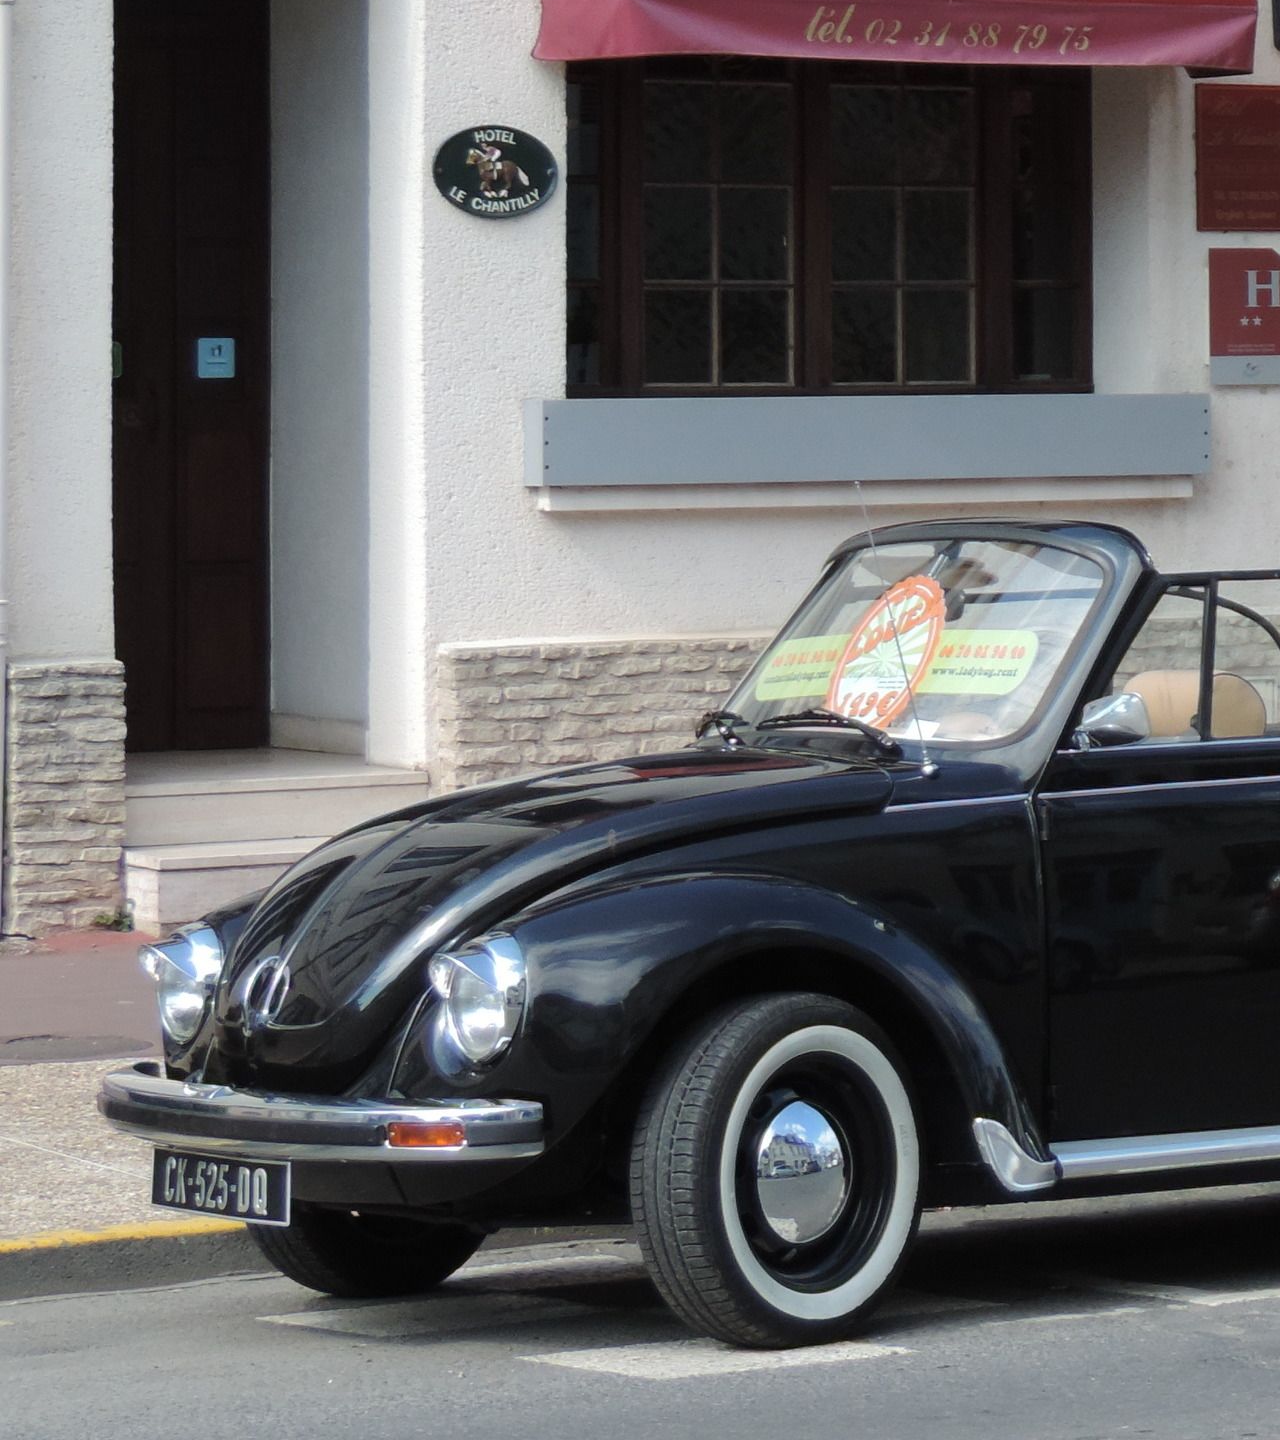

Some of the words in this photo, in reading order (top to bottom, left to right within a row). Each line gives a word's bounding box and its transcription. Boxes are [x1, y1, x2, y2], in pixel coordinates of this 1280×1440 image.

[865, 18, 902, 45] 02
[913, 21, 952, 47] 31
[963, 23, 1002, 48] 88
[1012, 24, 1048, 55] 79
[1058, 26, 1095, 56] 75
[474, 129, 517, 145] HOTEL
[449, 186, 468, 204] LE
[471, 188, 541, 213] CHANTILLY
[163, 1156, 268, 1216] CK-525-DQ
